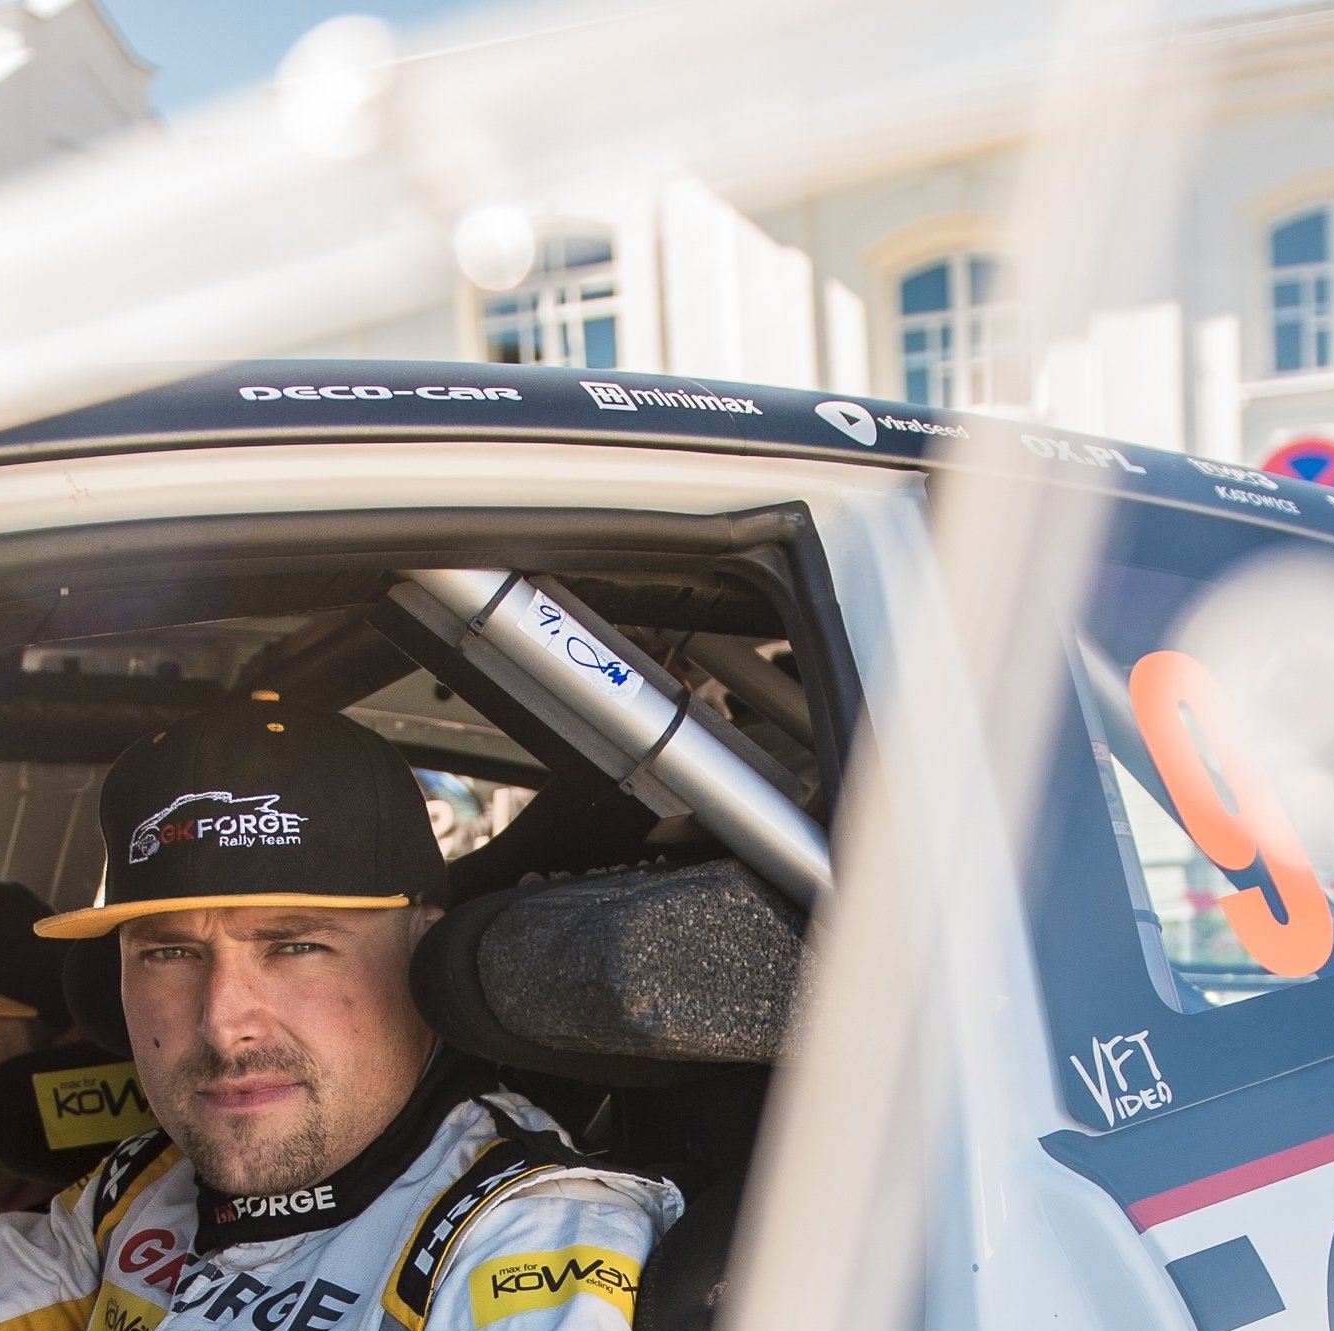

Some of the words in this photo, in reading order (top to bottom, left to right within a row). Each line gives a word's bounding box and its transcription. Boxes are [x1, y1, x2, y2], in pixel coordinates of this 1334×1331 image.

[239, 386, 523, 401] DECO-CAR
[632, 388, 764, 416] minimax
[876, 415, 970, 441] viralseed
[1213, 484, 1302, 516] KATOWICE
[1130, 650, 1334, 978] 9
[218, 835, 256, 848] Rally
[258, 833, 302, 846] Team
[499, 1266, 521, 1276] max
[524, 1263, 538, 1272] for
